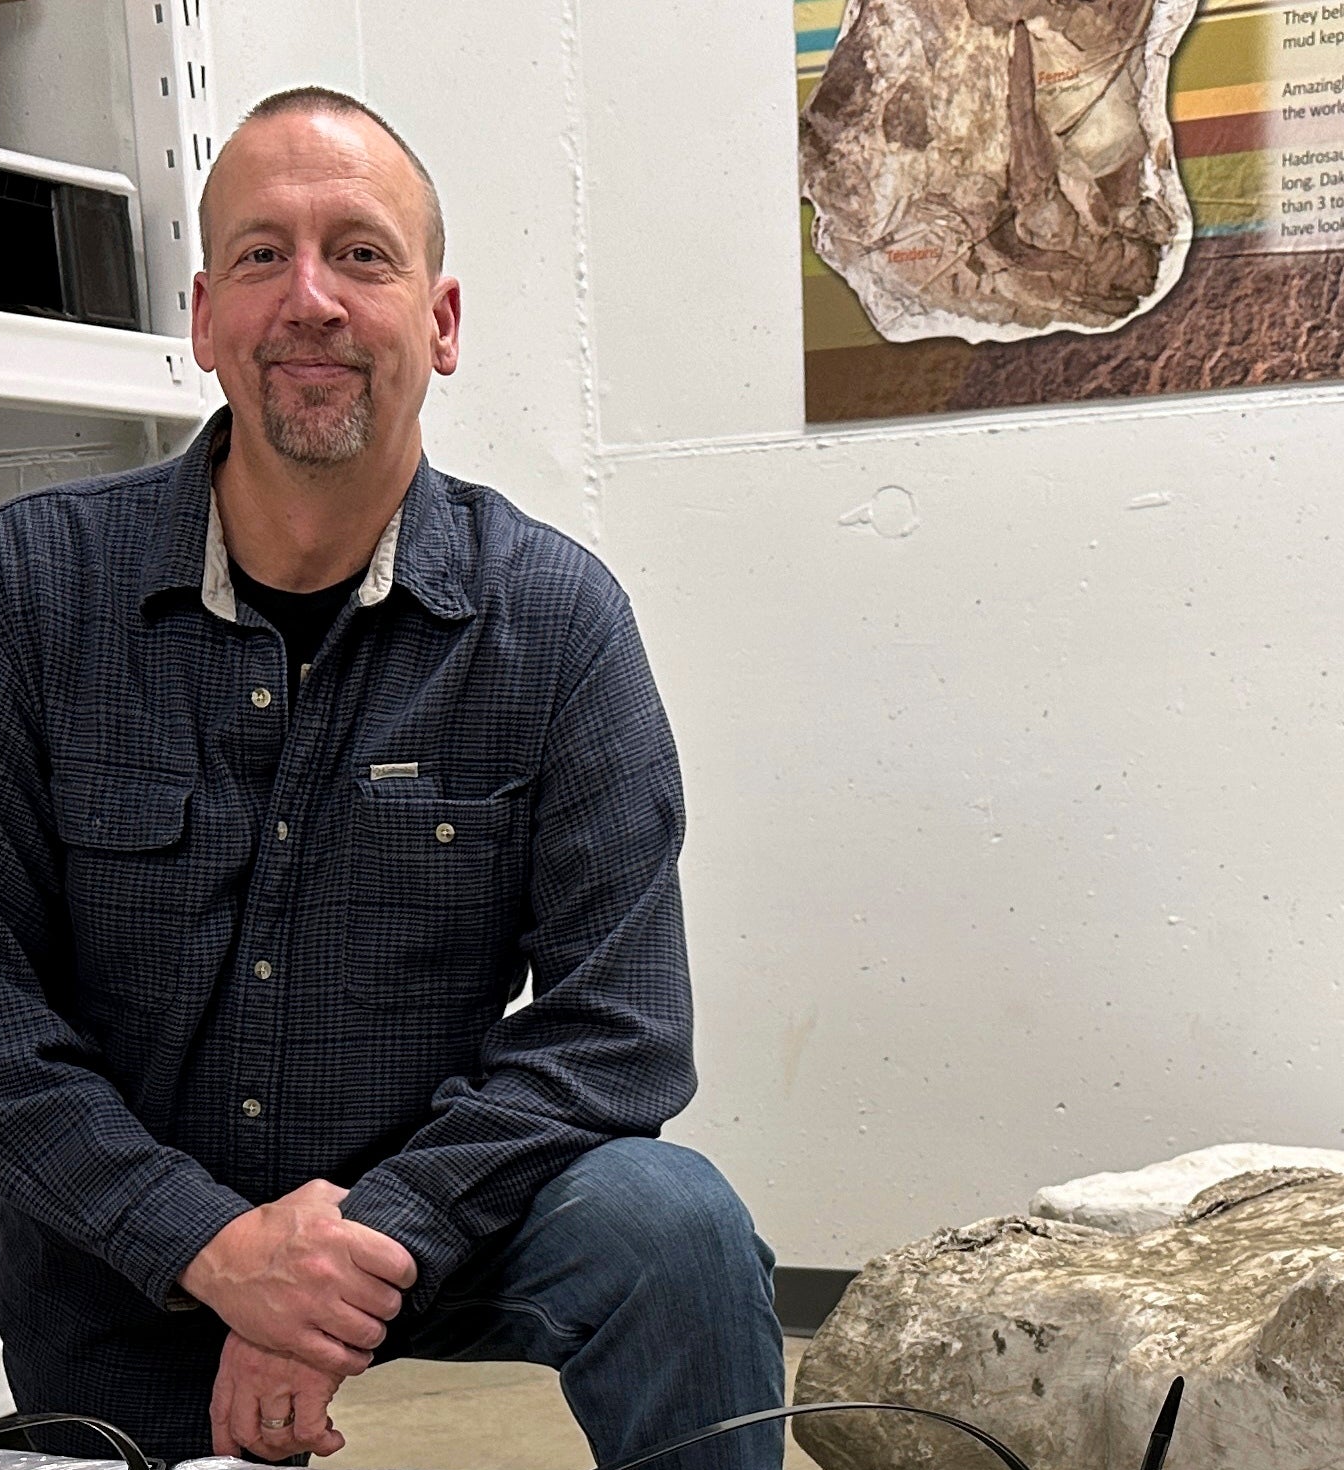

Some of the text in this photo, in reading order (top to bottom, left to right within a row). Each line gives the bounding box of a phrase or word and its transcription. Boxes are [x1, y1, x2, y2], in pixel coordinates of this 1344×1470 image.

[1283, 9, 1318, 26] They
[1283, 30, 1316, 49] mud
[1282, 105, 1306, 121] the
[1281, 176, 1316, 192] long.
[1281, 199, 1313, 214] than
[1317, 196, 1326, 210] 3
[1281, 222, 1314, 237] have
